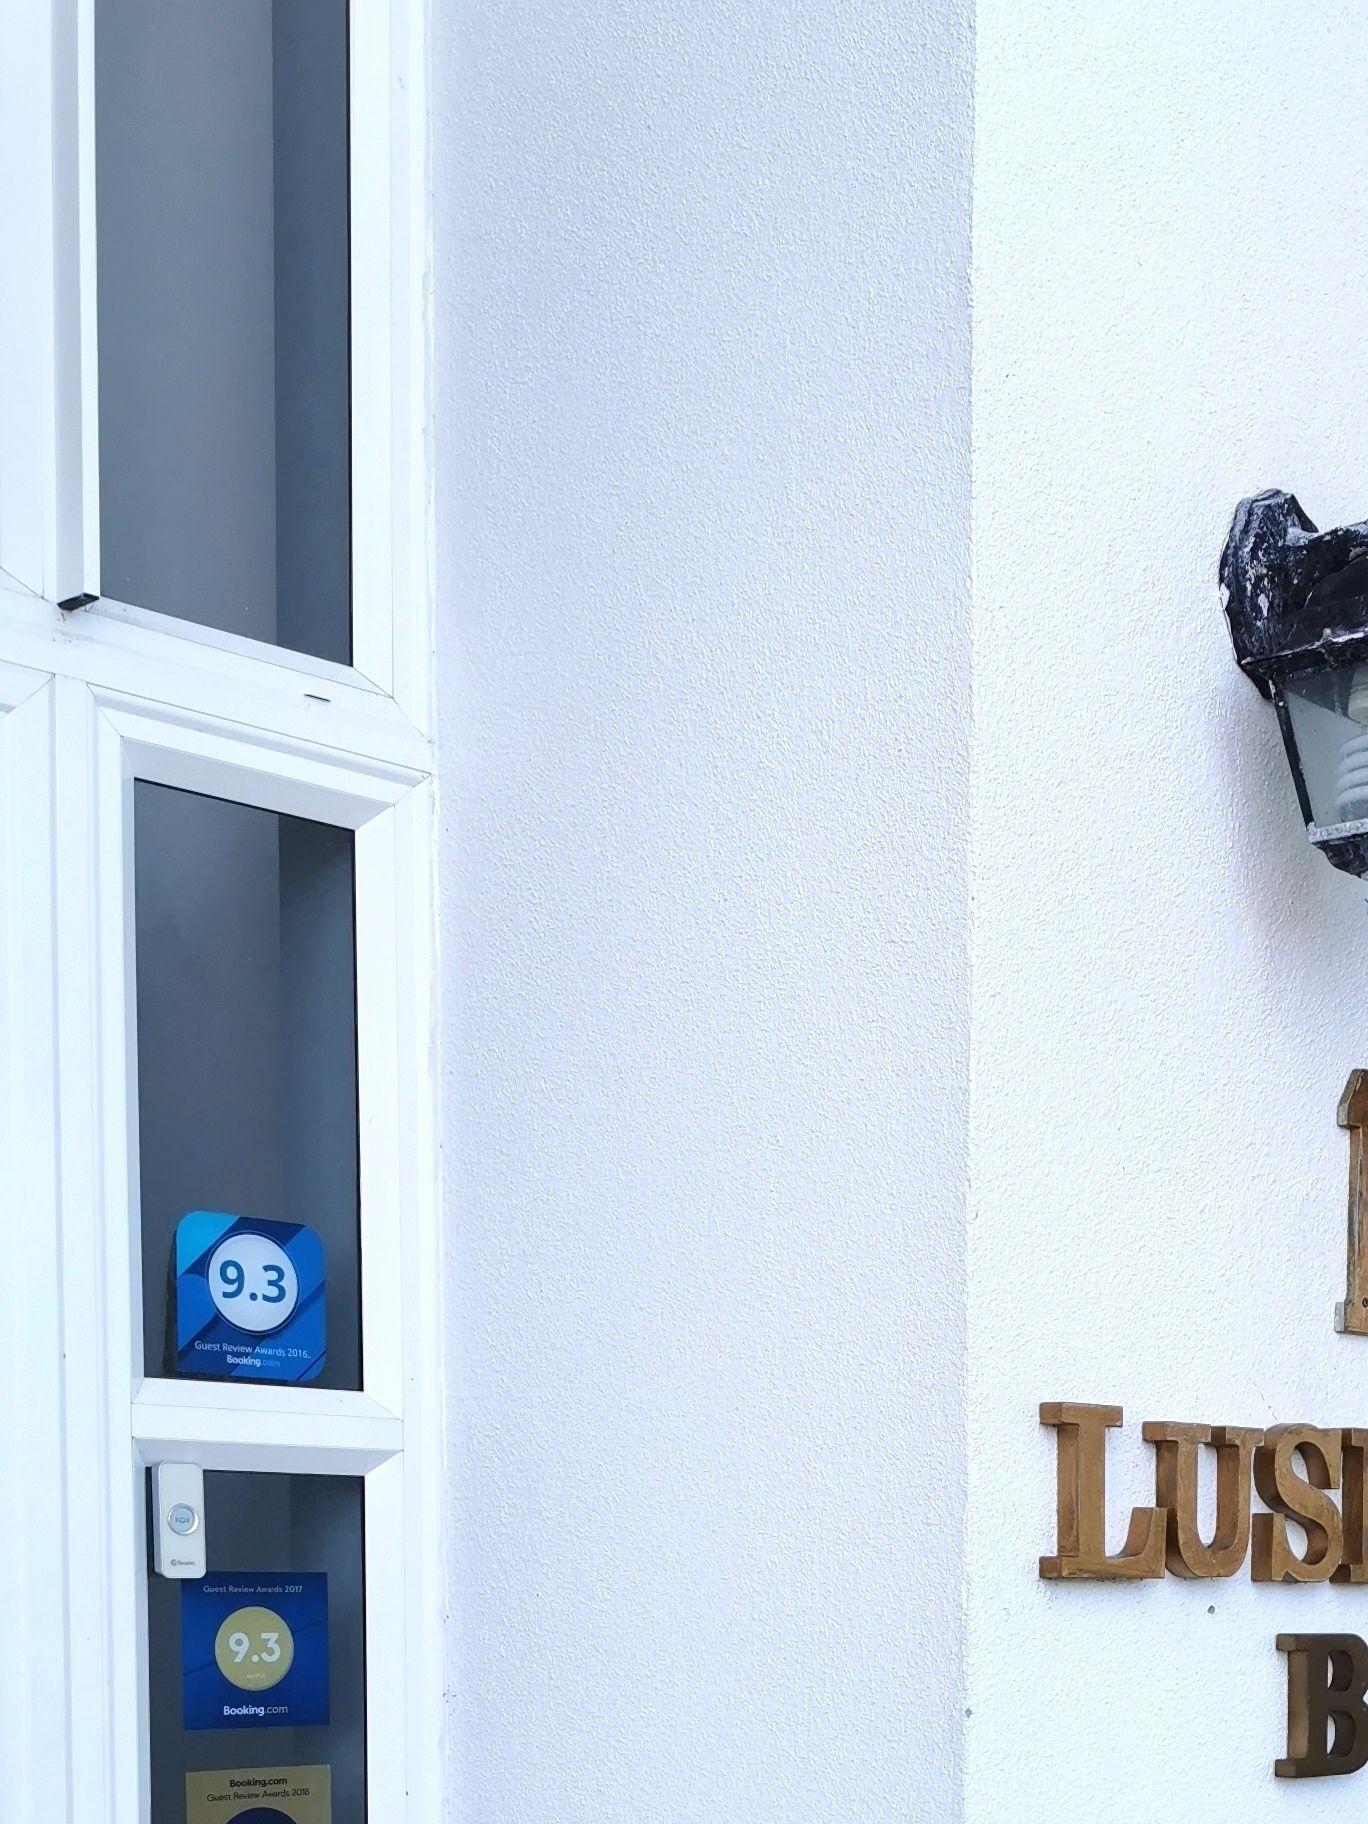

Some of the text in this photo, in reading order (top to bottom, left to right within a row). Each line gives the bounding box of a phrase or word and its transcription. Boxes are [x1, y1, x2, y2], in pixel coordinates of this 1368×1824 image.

[219, 1259, 286, 1303] 9.3
[195, 1340, 221, 1352] Guest
[222, 1343, 252, 1354] Review
[254, 1346, 286, 1358] Awards
[203, 1584, 303, 1593] Guest Review Awards 2017
[228, 1632, 281, 1663] 9.3
[223, 1704, 289, 1717] Booking.com
[229, 1778, 288, 1788] Booking.com
[206, 1788, 310, 1802] Guest Review Awards 2018
